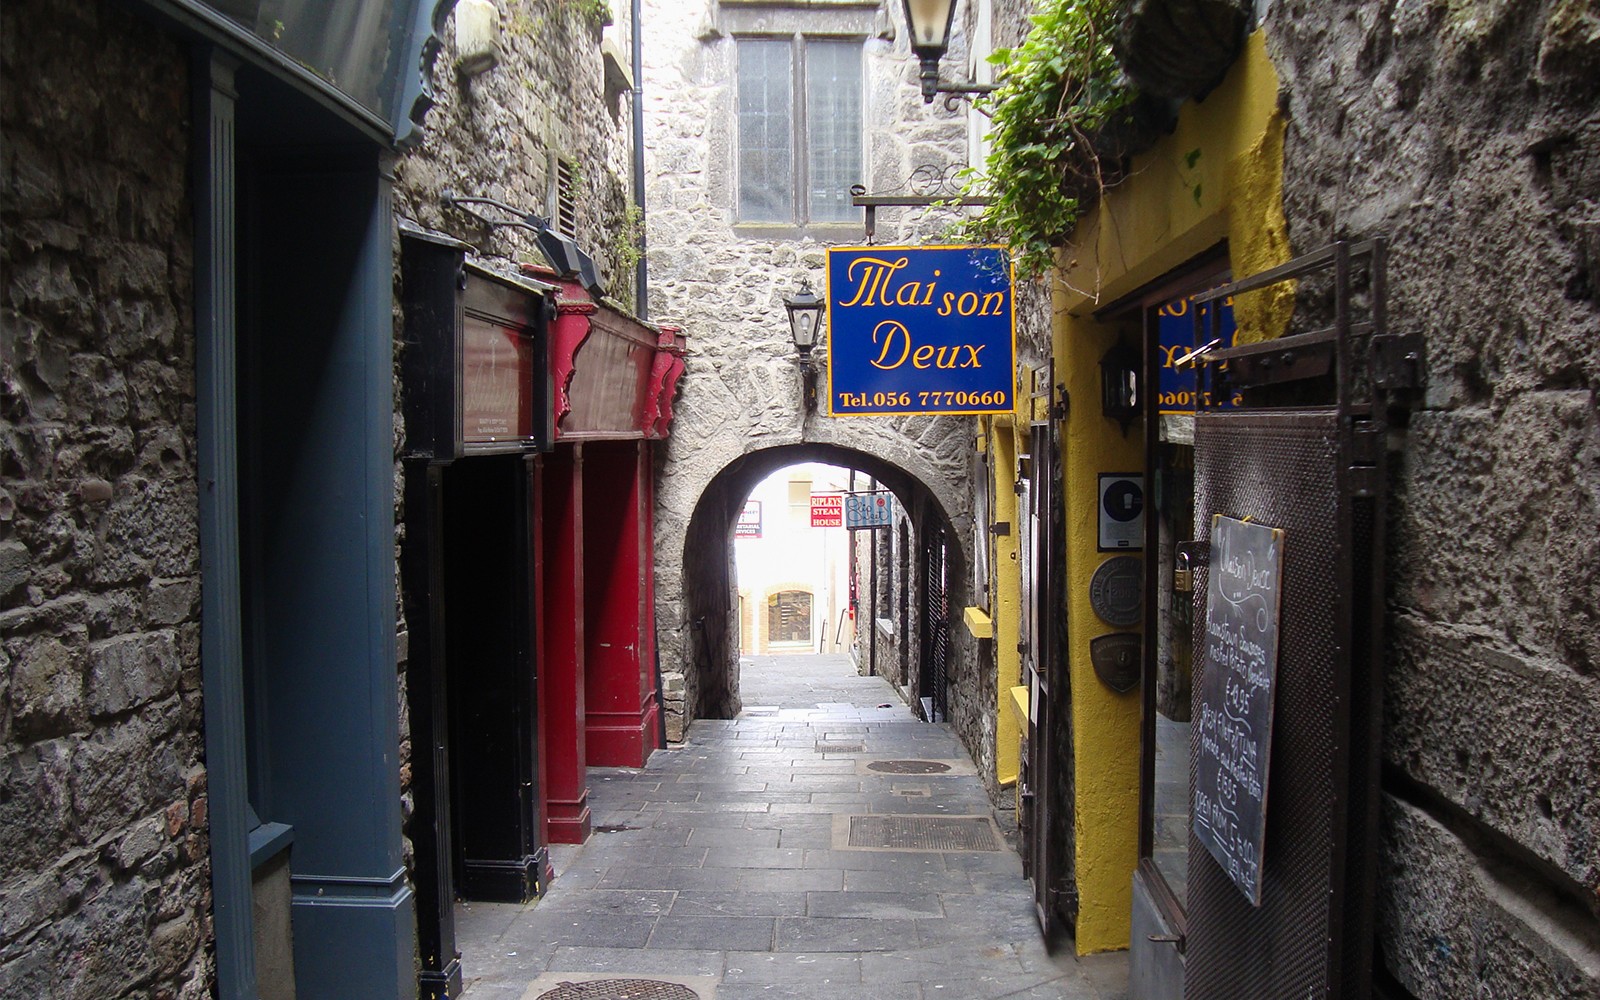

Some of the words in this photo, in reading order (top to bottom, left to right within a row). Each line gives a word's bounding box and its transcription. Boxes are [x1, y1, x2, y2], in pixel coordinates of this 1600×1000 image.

[839, 257, 1004, 316] Maison
[870, 320, 986, 370] Deux
[918, 390, 1006, 406] 7770660
[811, 497, 841, 506] RIPLEYS
[1196, 790, 1212, 816] OPEN
[1212, 803, 1228, 836] FROM
[1229, 823, 1238, 852] 5
